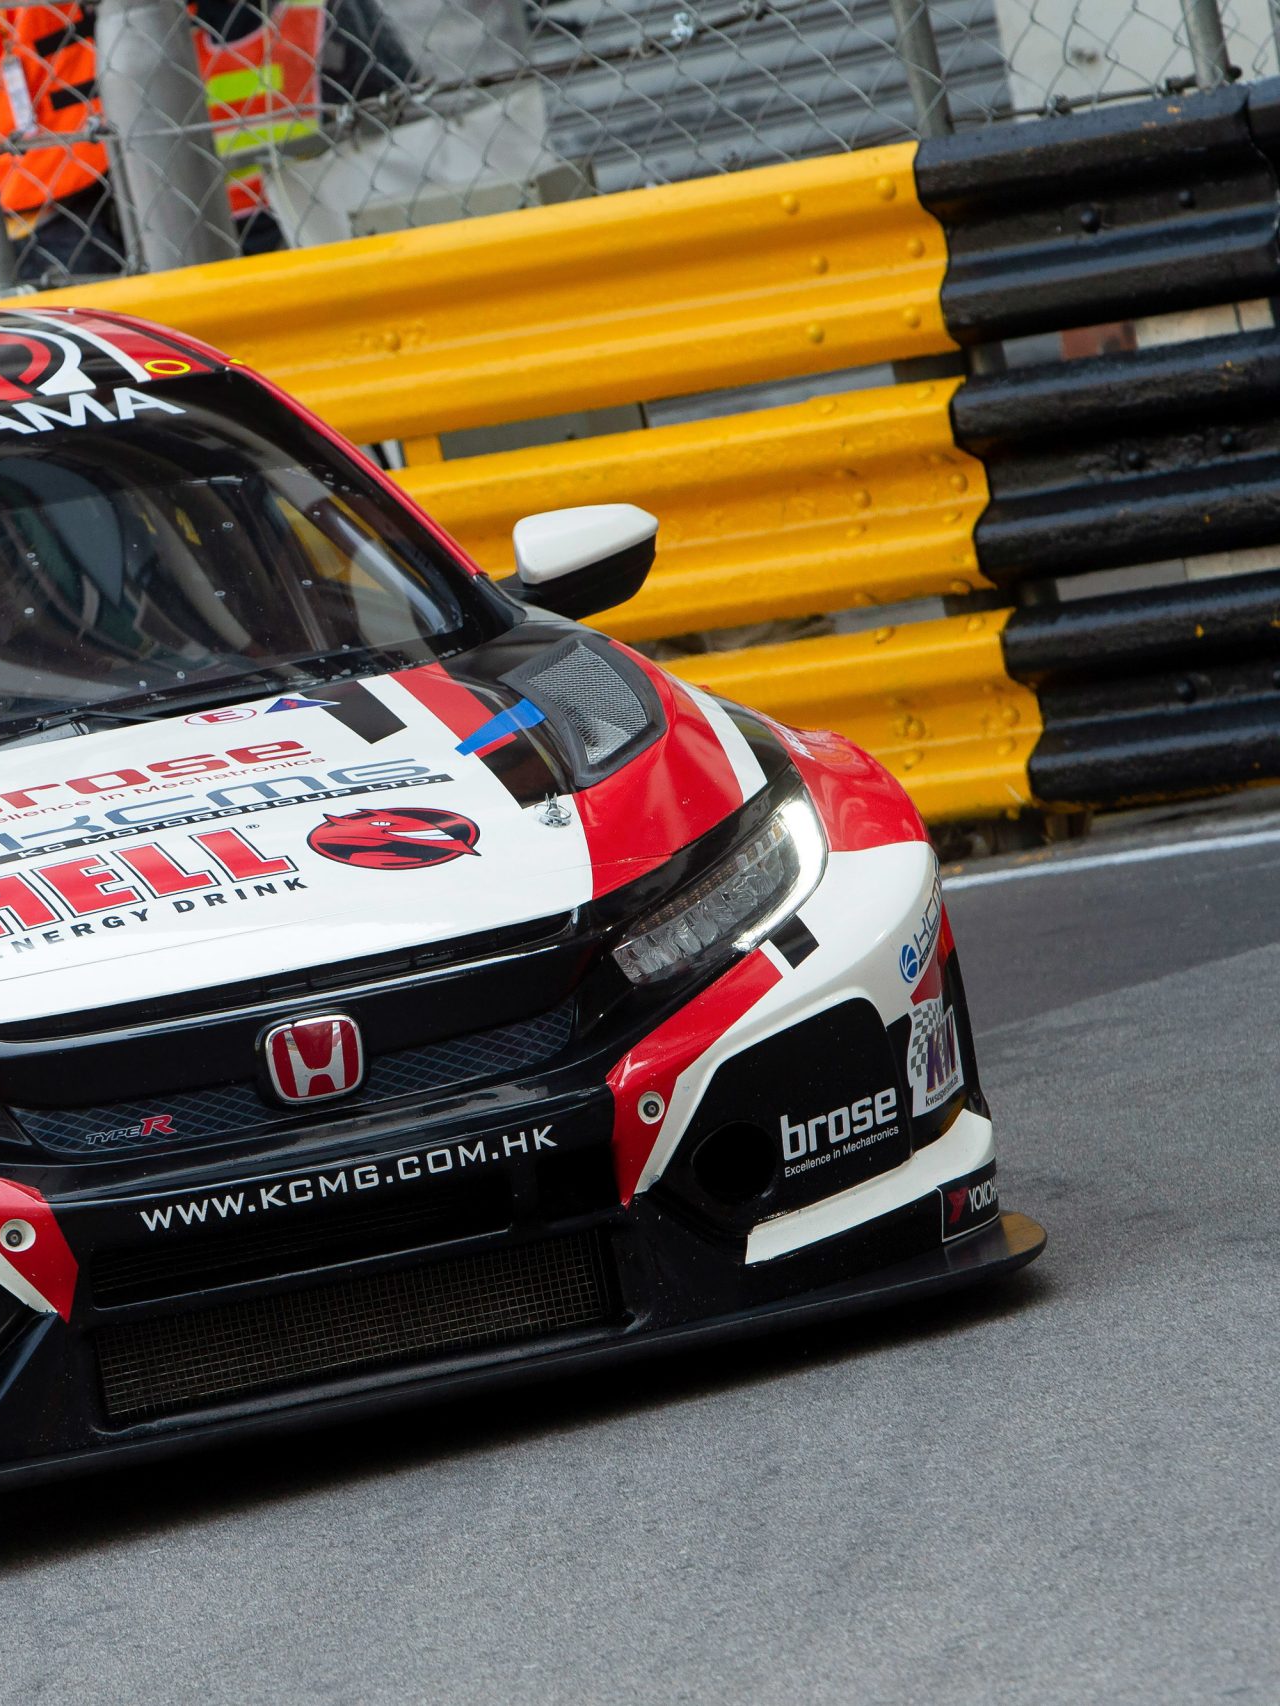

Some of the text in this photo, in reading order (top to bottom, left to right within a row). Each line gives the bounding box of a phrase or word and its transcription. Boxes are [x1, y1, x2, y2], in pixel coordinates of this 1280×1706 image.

[99, 792, 125, 802] in
[134, 756, 326, 795] Mechatronics
[17, 775, 445, 858] KC MOTORGROUP LTD.
[172, 876, 308, 914] DRINK
[85, 1114, 177, 1146] TYPE R
[780, 1087, 898, 1161] brose
[784, 1125, 900, 1178] Excellence in Mechatronics
[139, 1124, 558, 1233] WWW.KCMG.COM.HK
